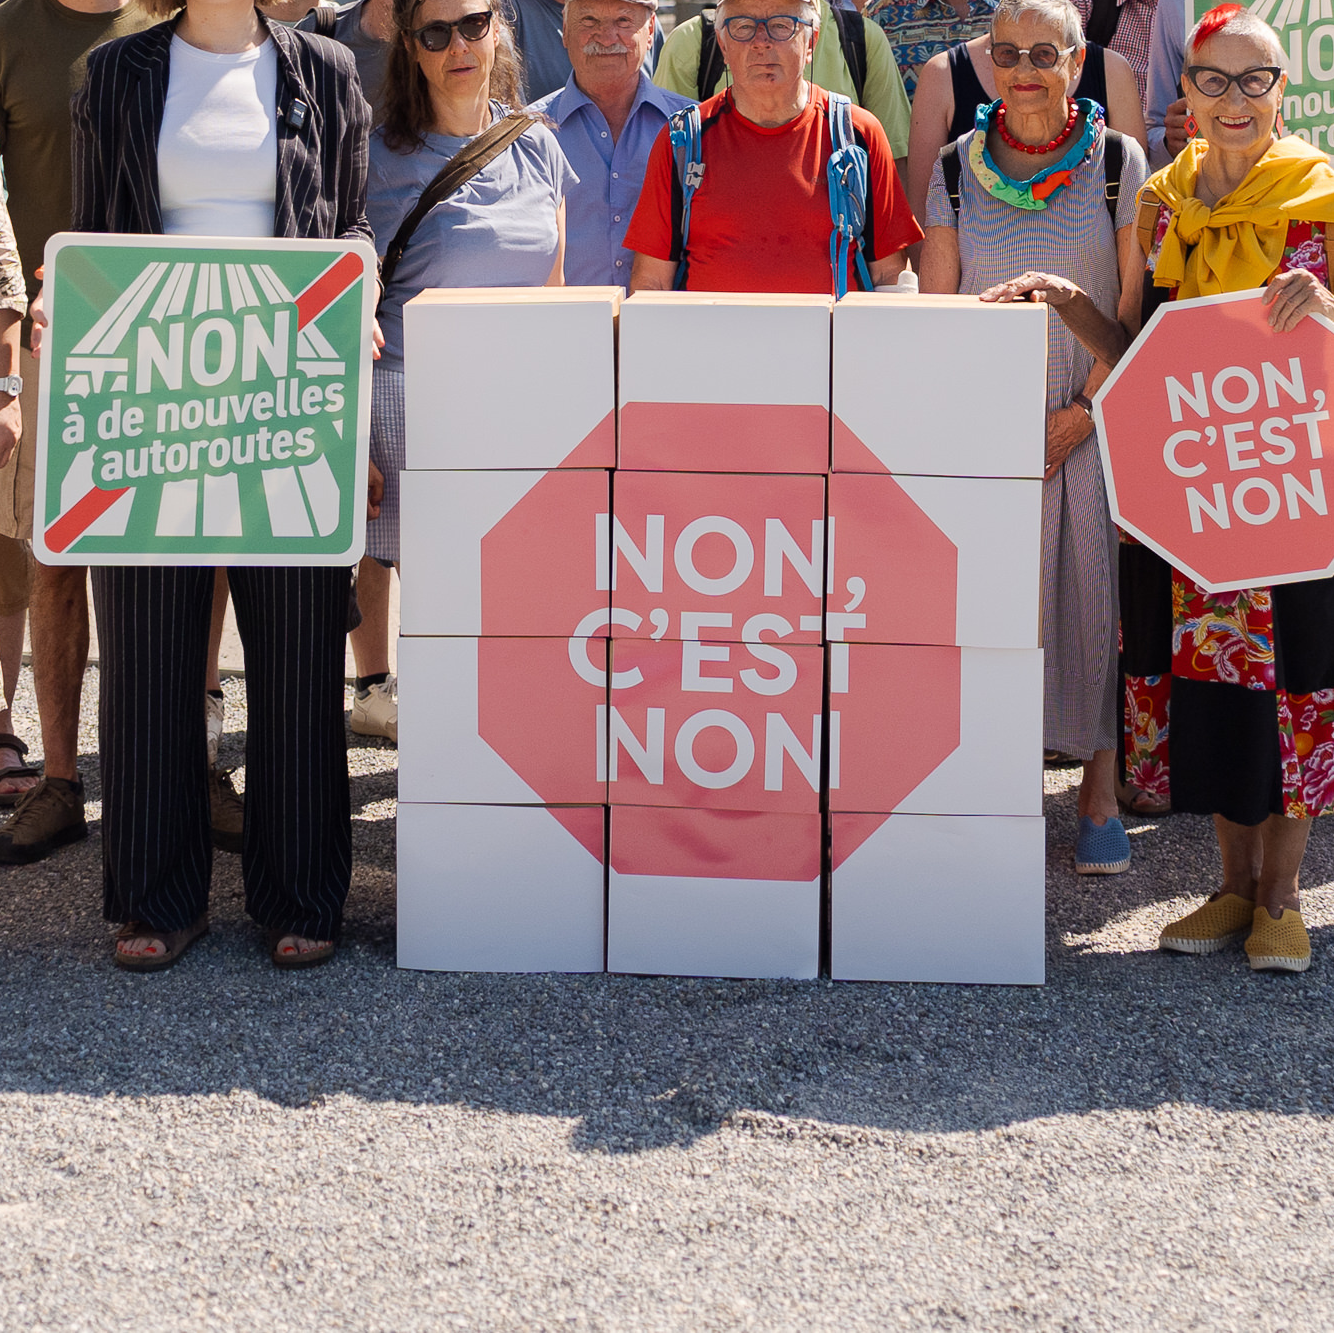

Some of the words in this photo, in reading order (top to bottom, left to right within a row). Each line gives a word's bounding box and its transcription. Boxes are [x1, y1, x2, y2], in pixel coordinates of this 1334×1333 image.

[135, 310, 290, 394] NON
[61, 402, 85, 445] à
[97, 399, 144, 440] de
[156, 378, 345, 433] nouvelles
[1165, 357, 1326, 422] NON,
[100, 426, 315, 481] autoroutes
[1163, 410, 1330, 477] C’EST
[1185, 469, 1329, 533] NON
[595, 513, 867, 613] NON,
[568, 607, 867, 696] C’EST
[596, 704, 841, 793] NON
